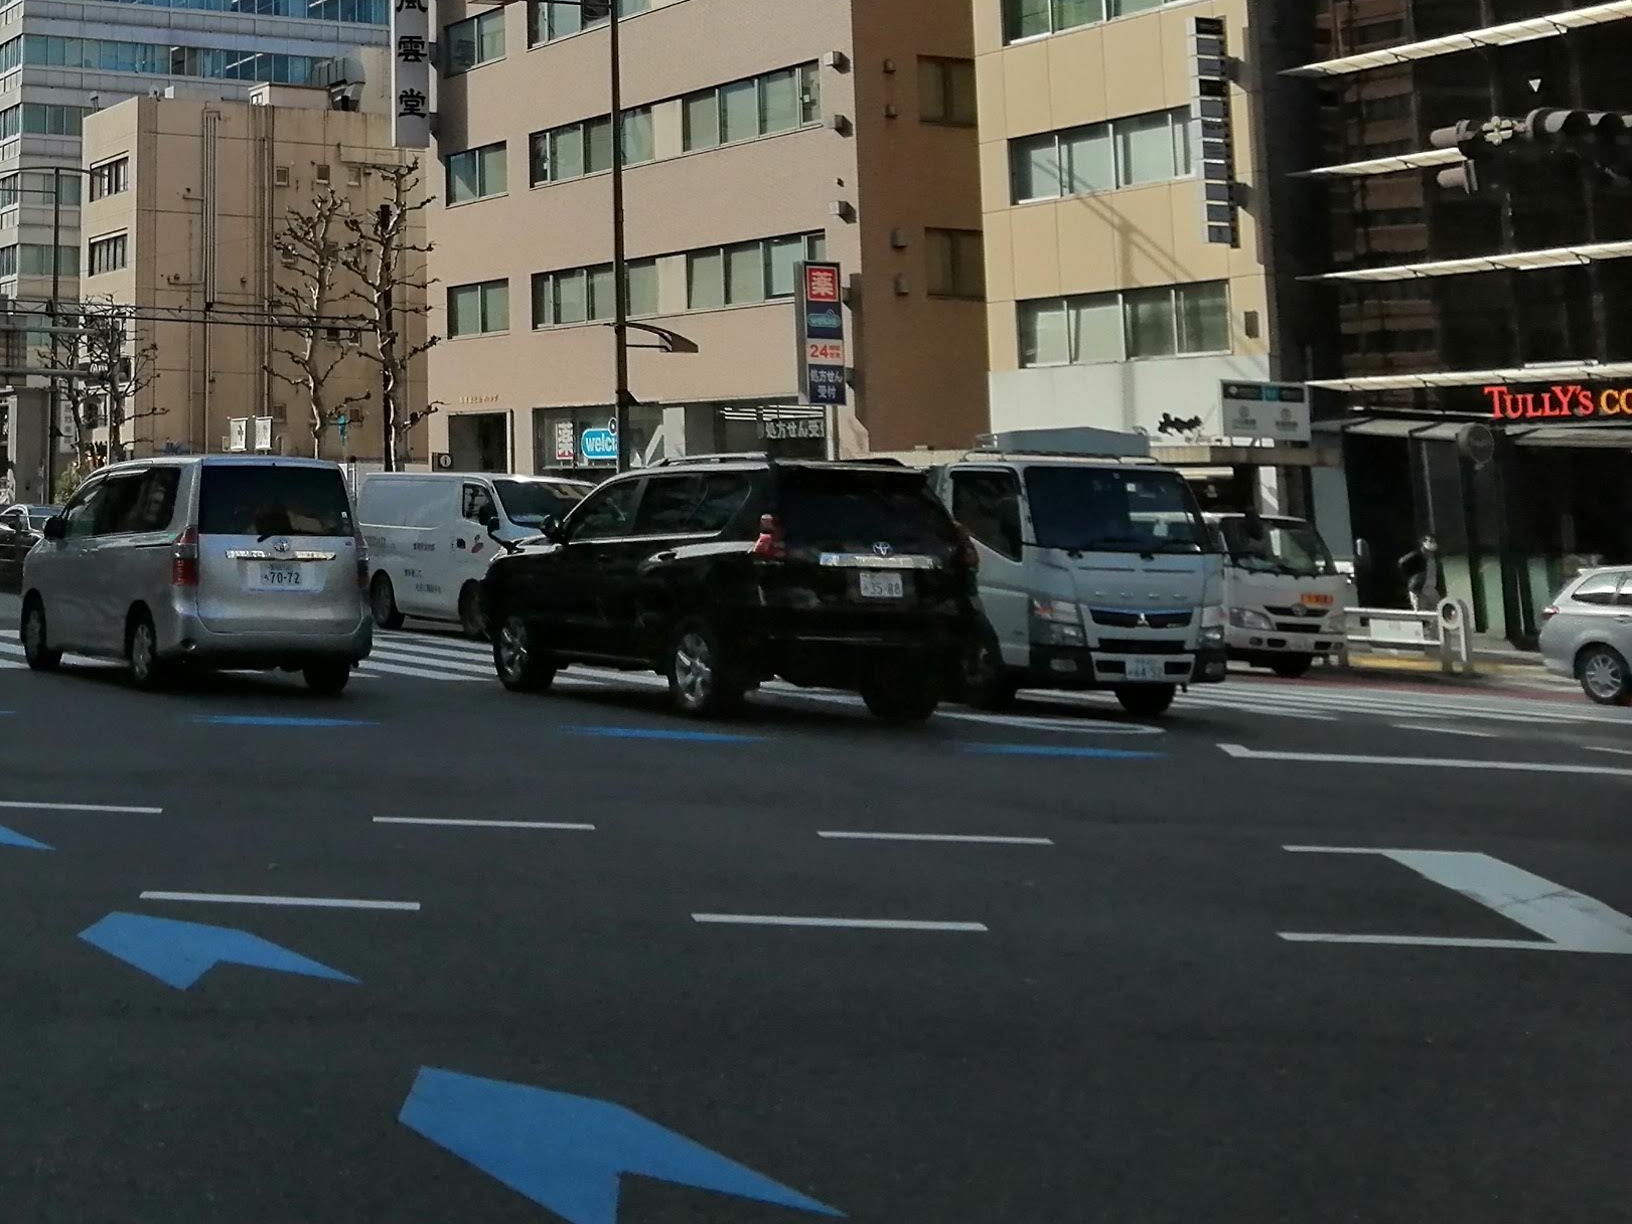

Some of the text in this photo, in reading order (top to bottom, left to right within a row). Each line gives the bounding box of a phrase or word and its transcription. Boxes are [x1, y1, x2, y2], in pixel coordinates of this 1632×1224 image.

[811, 272, 834, 296] 薬
[809, 344, 828, 358] 24
[811, 369, 842, 383] 処方せん
[817, 385, 837, 400] 受付
